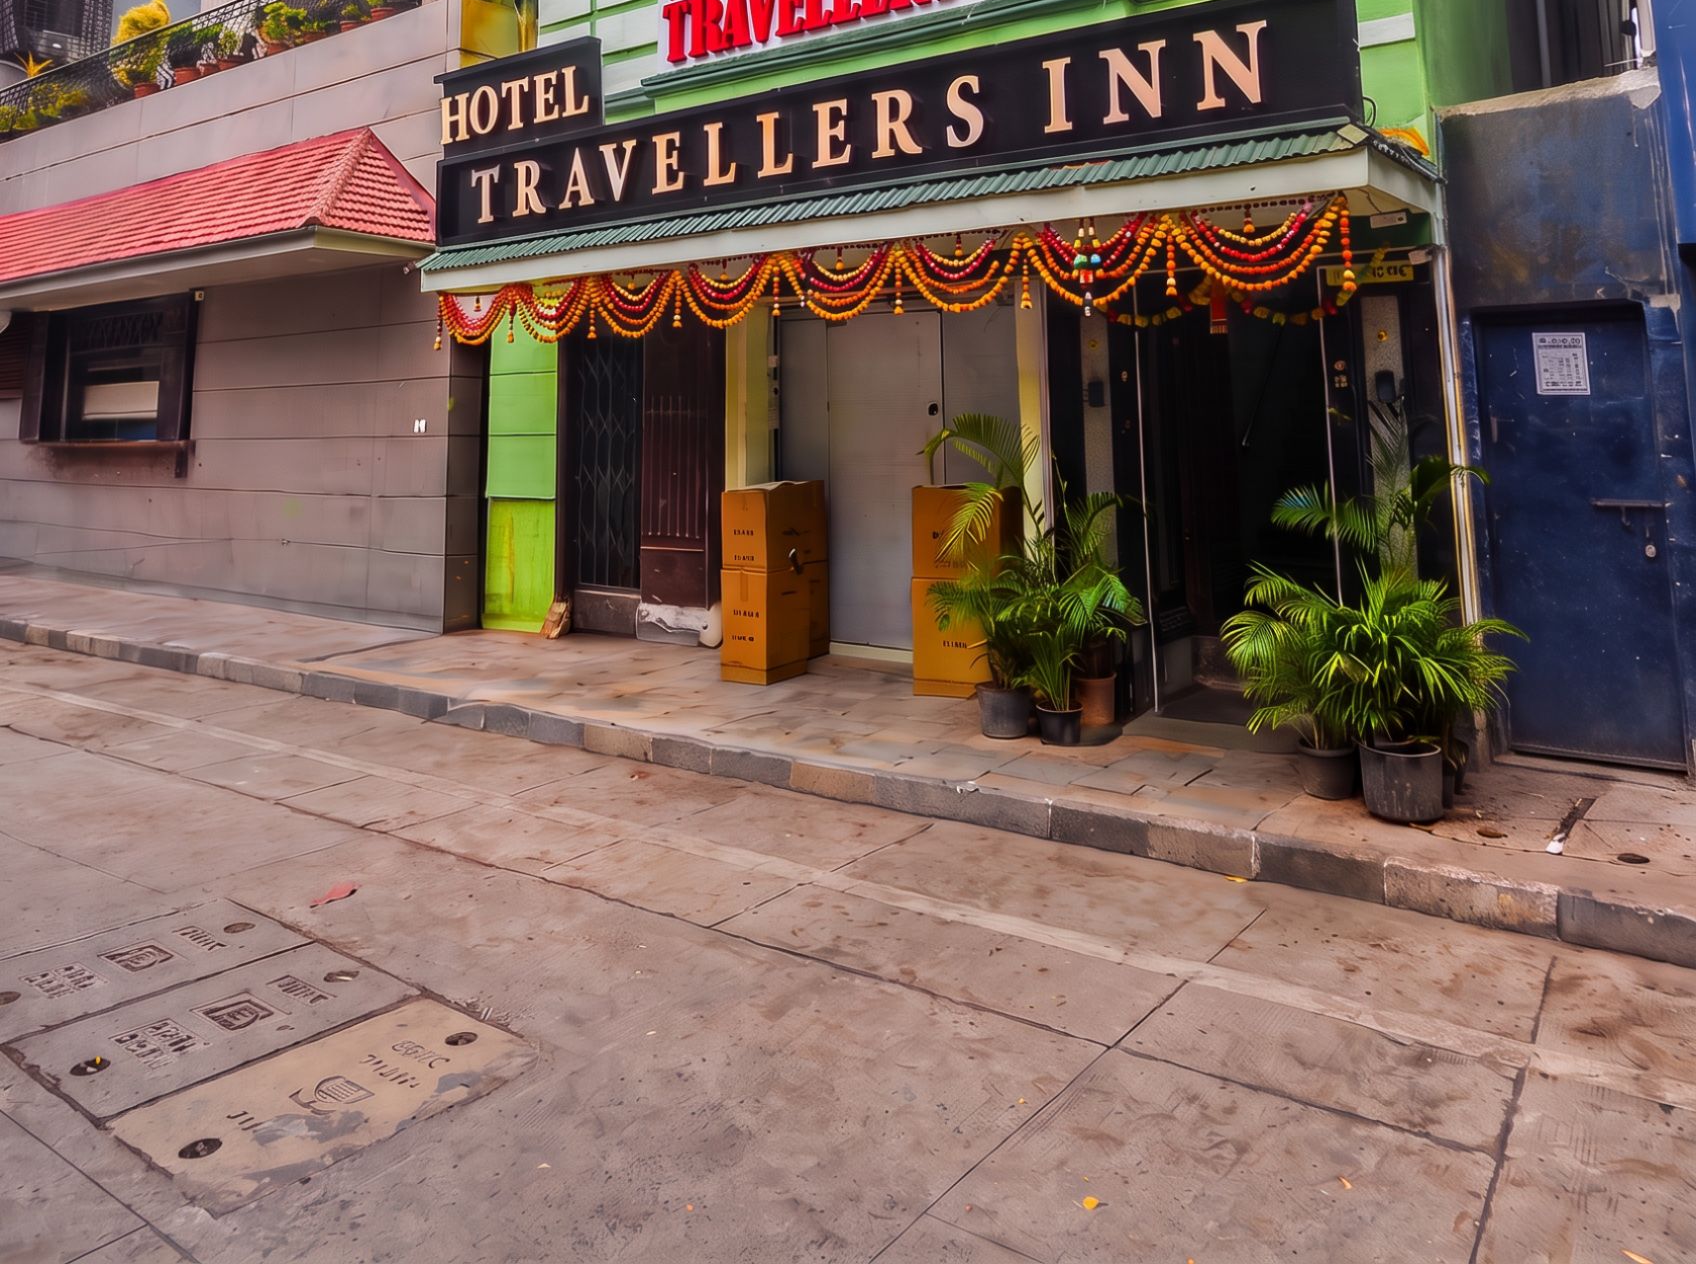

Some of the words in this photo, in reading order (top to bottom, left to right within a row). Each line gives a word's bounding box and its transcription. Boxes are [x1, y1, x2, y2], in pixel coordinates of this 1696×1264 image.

[440, 65, 589, 146] HOTEL
[471, 74, 984, 224] TRAVELLERS
[1042, 19, 1268, 134] INN
